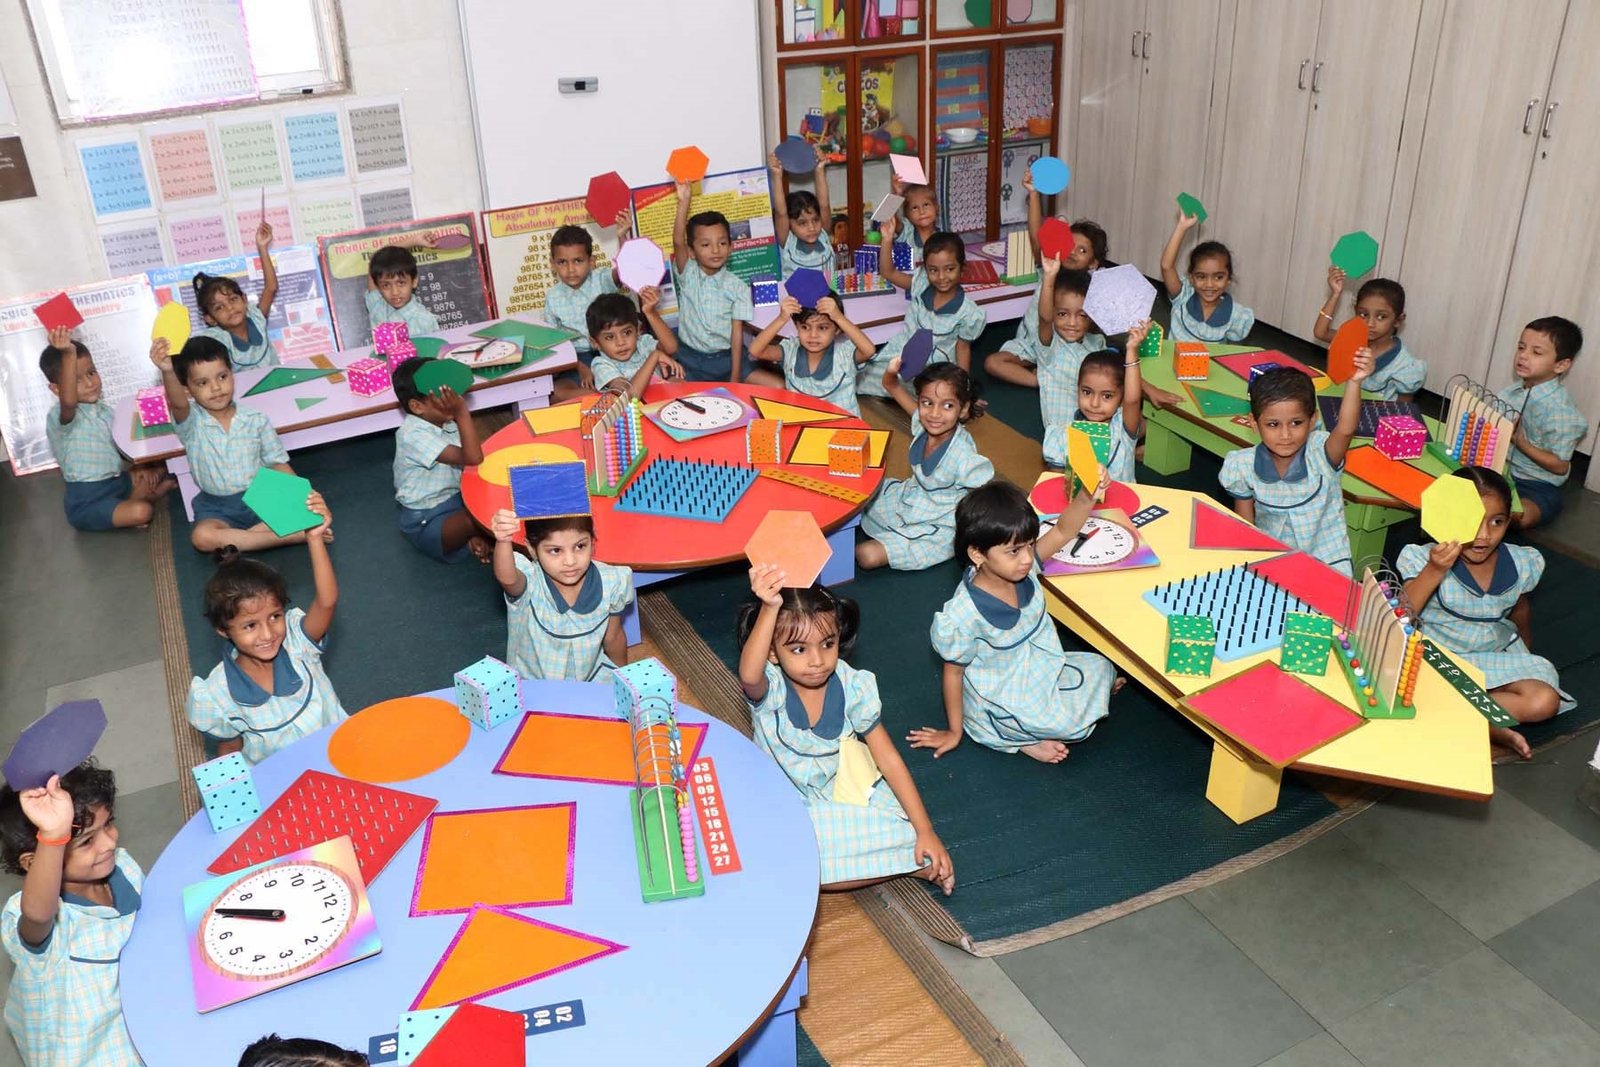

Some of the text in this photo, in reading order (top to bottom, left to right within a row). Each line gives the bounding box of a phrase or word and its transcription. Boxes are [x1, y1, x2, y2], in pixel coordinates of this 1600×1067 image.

[544, 200, 587, 214] MATHEM
[524, 254, 540, 262] 987
[520, 263, 542, 273] 9876
[427, 272, 434, 281] 9
[516, 272, 544, 283] 98765
[430, 281, 441, 291] 98
[513, 281, 544, 293] 987654
[71, 286, 135, 306] HEMATICS
[432, 291, 447, 302] 987
[433, 301, 455, 312] 9876
[693, 762, 710, 773] 03
[694, 773, 712, 784] 06
[697, 784, 715, 795] 09
[700, 796, 716, 806] 12
[703, 807, 719, 817] 15
[706, 819, 722, 829] 18
[709, 831, 725, 842] 21
[711, 843, 729, 854] 24
[714, 855, 731, 867] 27
[264, 879, 278, 889] 9
[290, 872, 305, 888] 10
[312, 879, 327, 893] 11
[239, 892, 253, 902] 8
[323, 892, 338, 909] 12
[321, 916, 335, 924] 1
[219, 931, 233, 940] 6
[304, 935, 319, 946] 2
[229, 946, 243, 956] 5
[279, 949, 293, 959] 3
[252, 954, 266, 963] 4
[533, 1009, 551, 1028] 04
[555, 1005, 573, 1024] 02
[379, 1037, 397, 1055] 18
